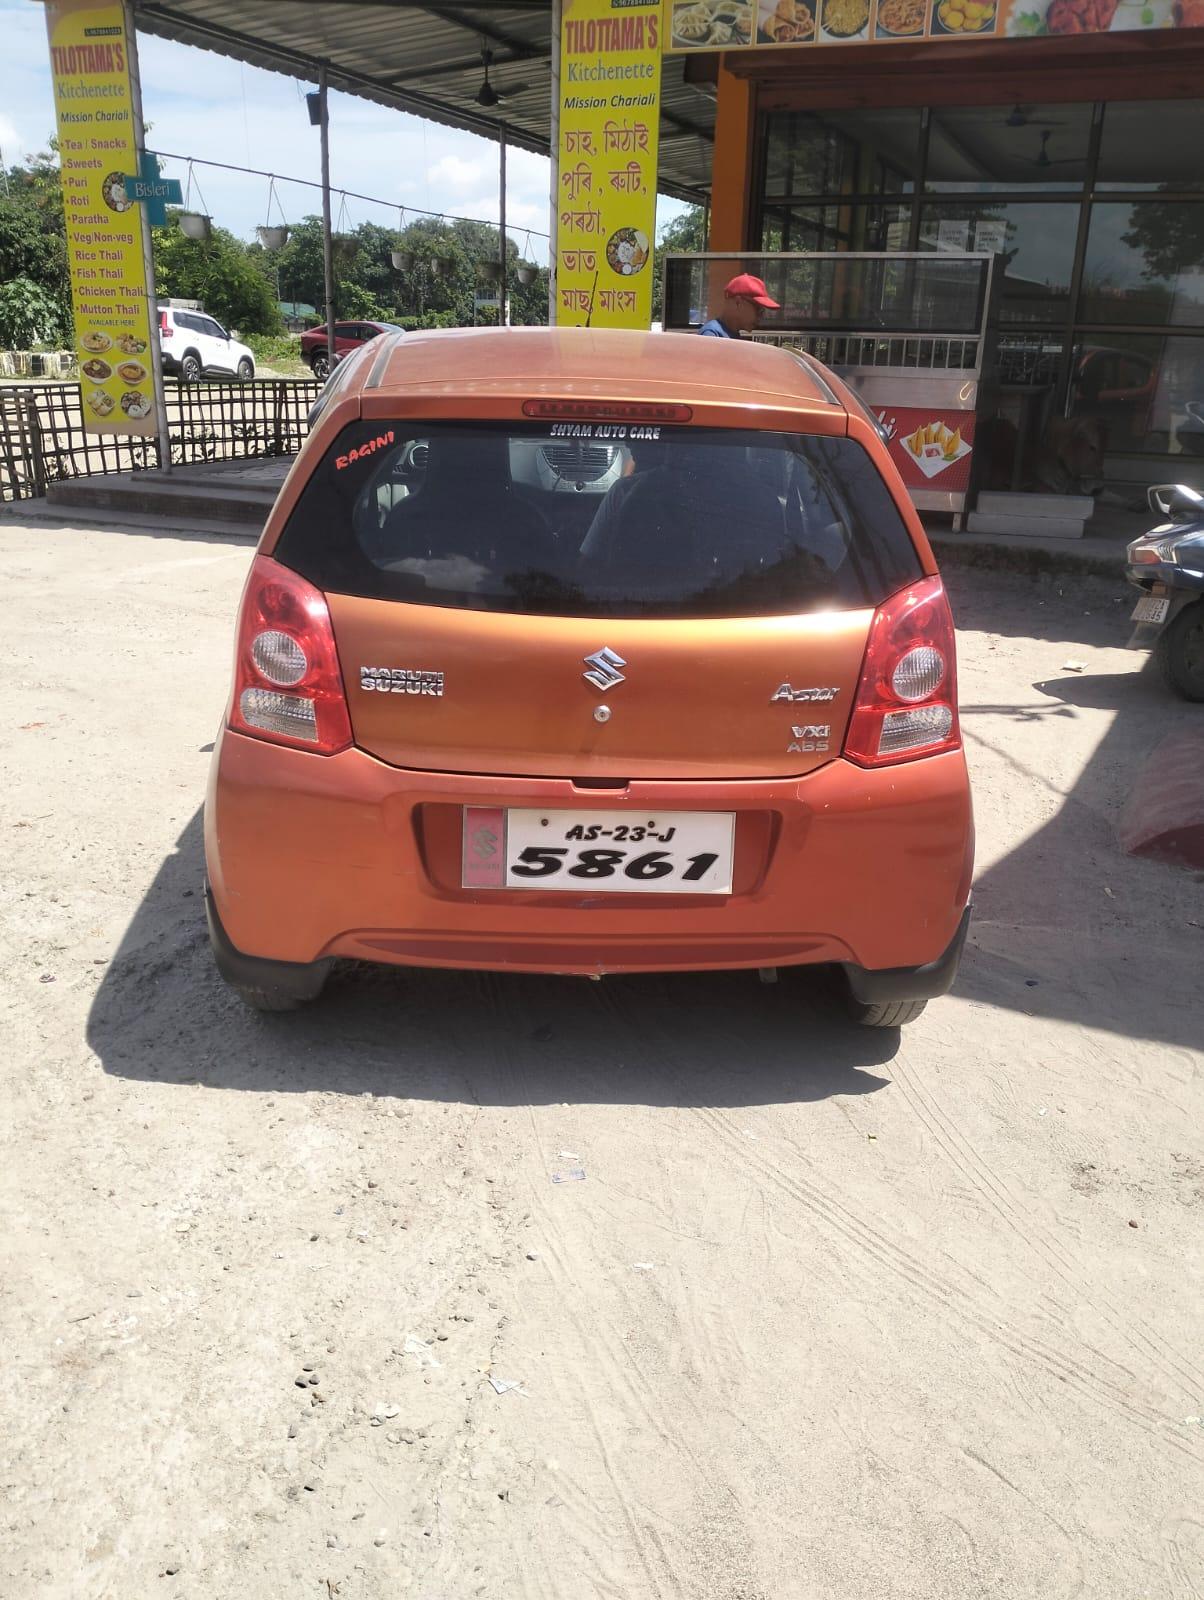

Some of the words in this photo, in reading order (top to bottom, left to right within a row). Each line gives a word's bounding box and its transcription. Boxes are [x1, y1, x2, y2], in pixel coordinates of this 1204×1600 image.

[565, 14, 659, 55] TILOTTAMA'S
[52, 42, 125, 76] TILOTTAMA'S
[567, 59, 655, 82] Kitchenette
[57, 80, 125, 99] Kitchenette
[564, 97, 607, 109] Mission
[610, 93, 656, 107] Chariali
[61, 112, 93, 123] Mission
[95, 111, 129, 121] Chariali
[65, 140, 83, 149] Tea
[91, 138, 127, 149] Snacks
[67, 158, 103, 169] Sweets
[68, 177, 88, 187] Puri
[135, 182, 169, 198] Bisleri
[70, 195, 89, 206] Roti
[71, 214, 109, 224] Paratha
[75, 251, 97, 261] Rice
[99, 250, 124, 261] Thali
[76, 269, 97, 279] Fish
[99, 268, 124, 279] Thali
[78, 286, 116, 297] Chicken
[119, 286, 144, 297] Thali
[80, 304, 113, 315] Mutton
[115, 304, 140, 315] Thali
[88, 319, 119, 327] AVAILABLE
[550, 424, 592, 437] SHYAM
[595, 425, 626, 438] AUTO
[630, 427, 661, 440] CARE
[335, 431, 395, 471] RAGINI
[360, 666, 444, 683] MARUTI
[360, 678, 444, 696] SUZUKI
[786, 740, 829, 753] ABS
[565, 825, 676, 842] AS-23-J
[510, 846, 719, 880] 5861
